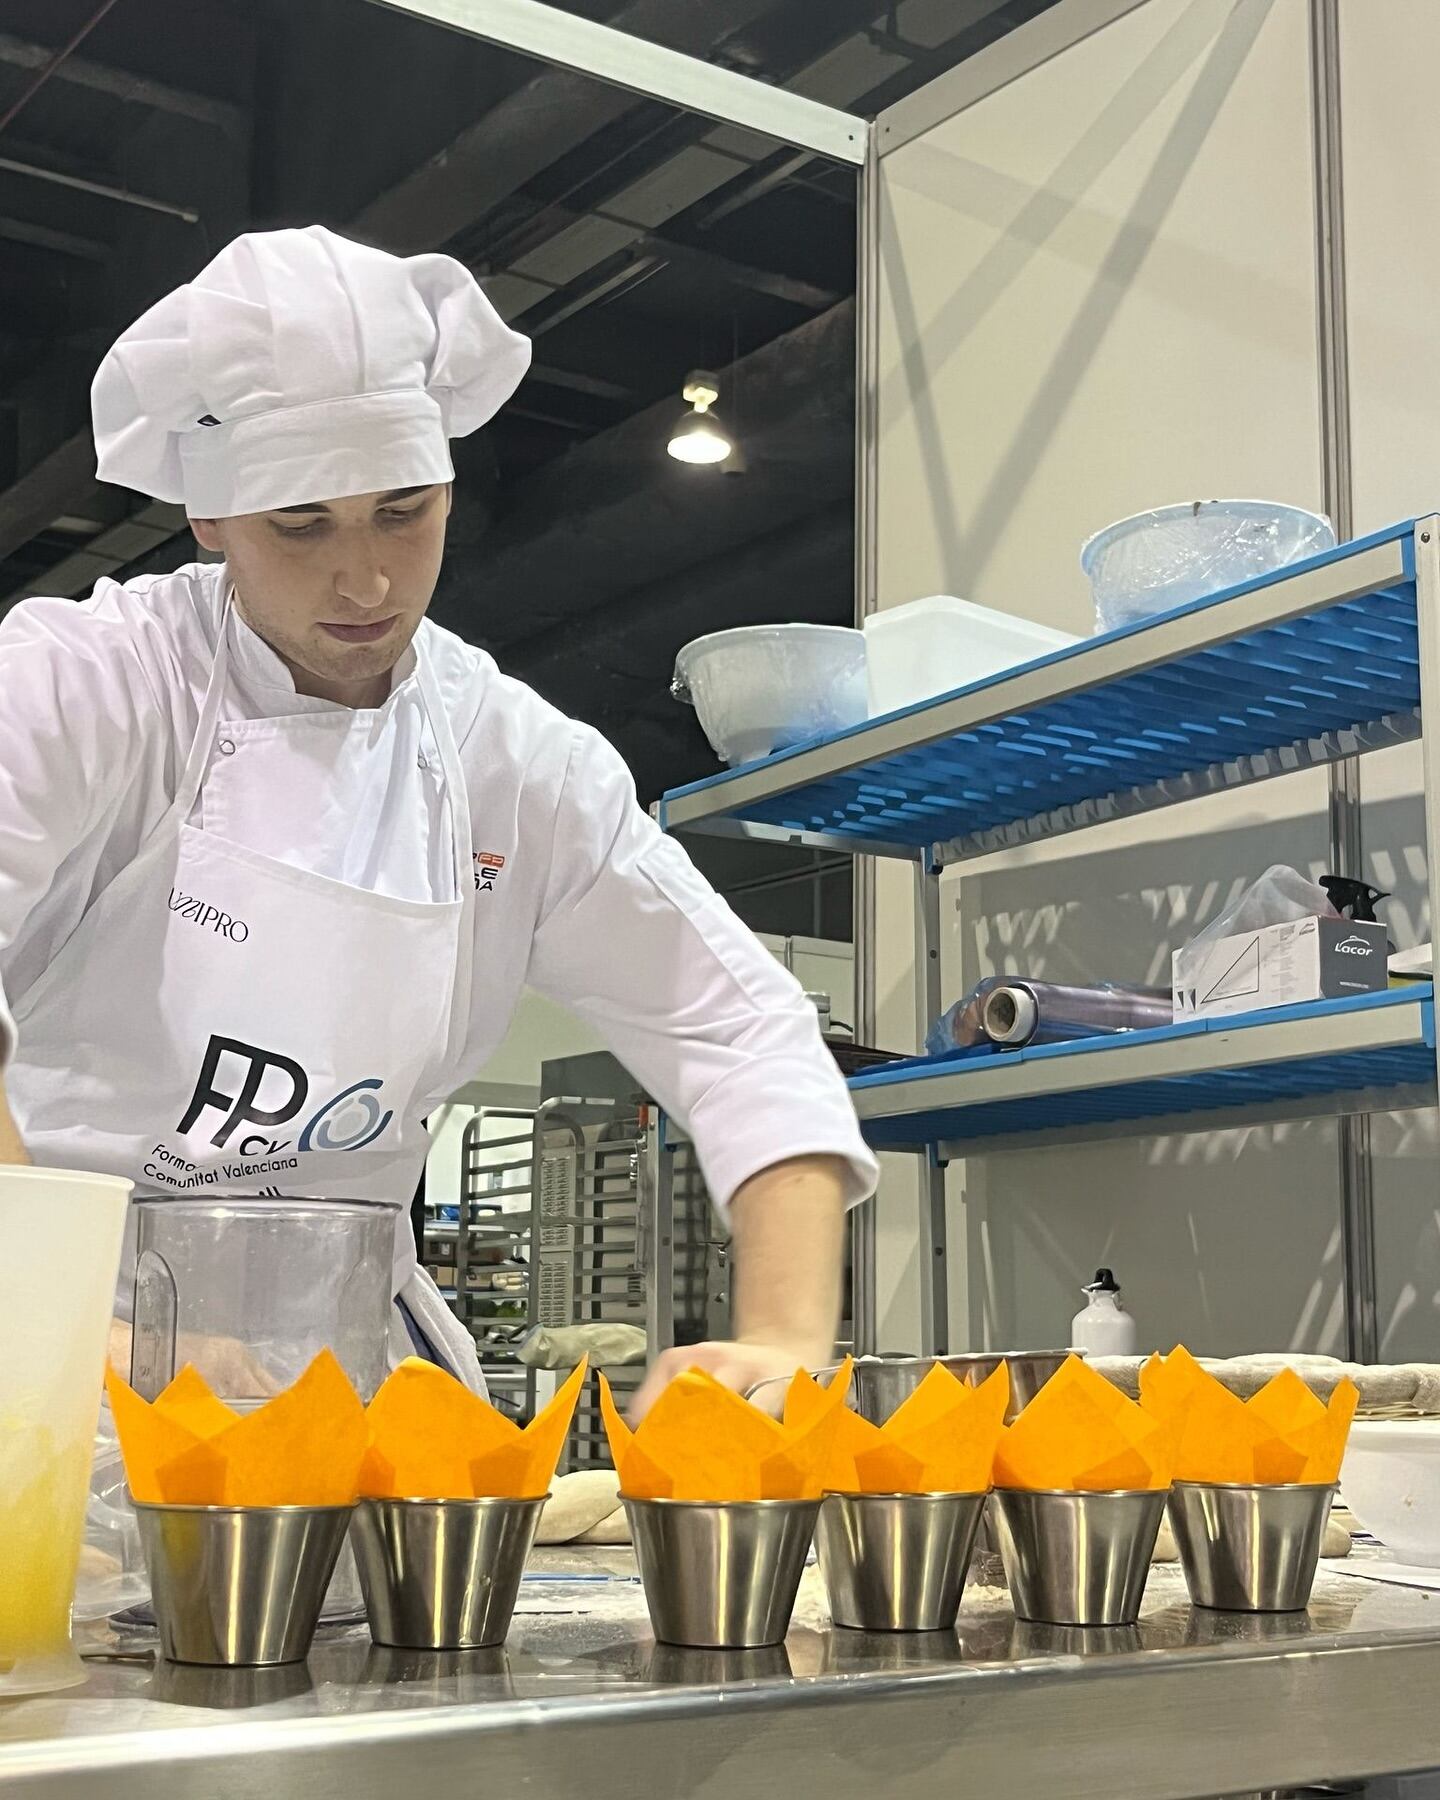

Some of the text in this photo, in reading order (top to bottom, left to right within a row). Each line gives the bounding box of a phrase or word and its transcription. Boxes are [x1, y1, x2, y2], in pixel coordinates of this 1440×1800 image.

[1334, 943, 1373, 956] Lacor
[176, 1034, 309, 1149] FP
[143, 1157, 298, 1189] Comunitat Valenciana
